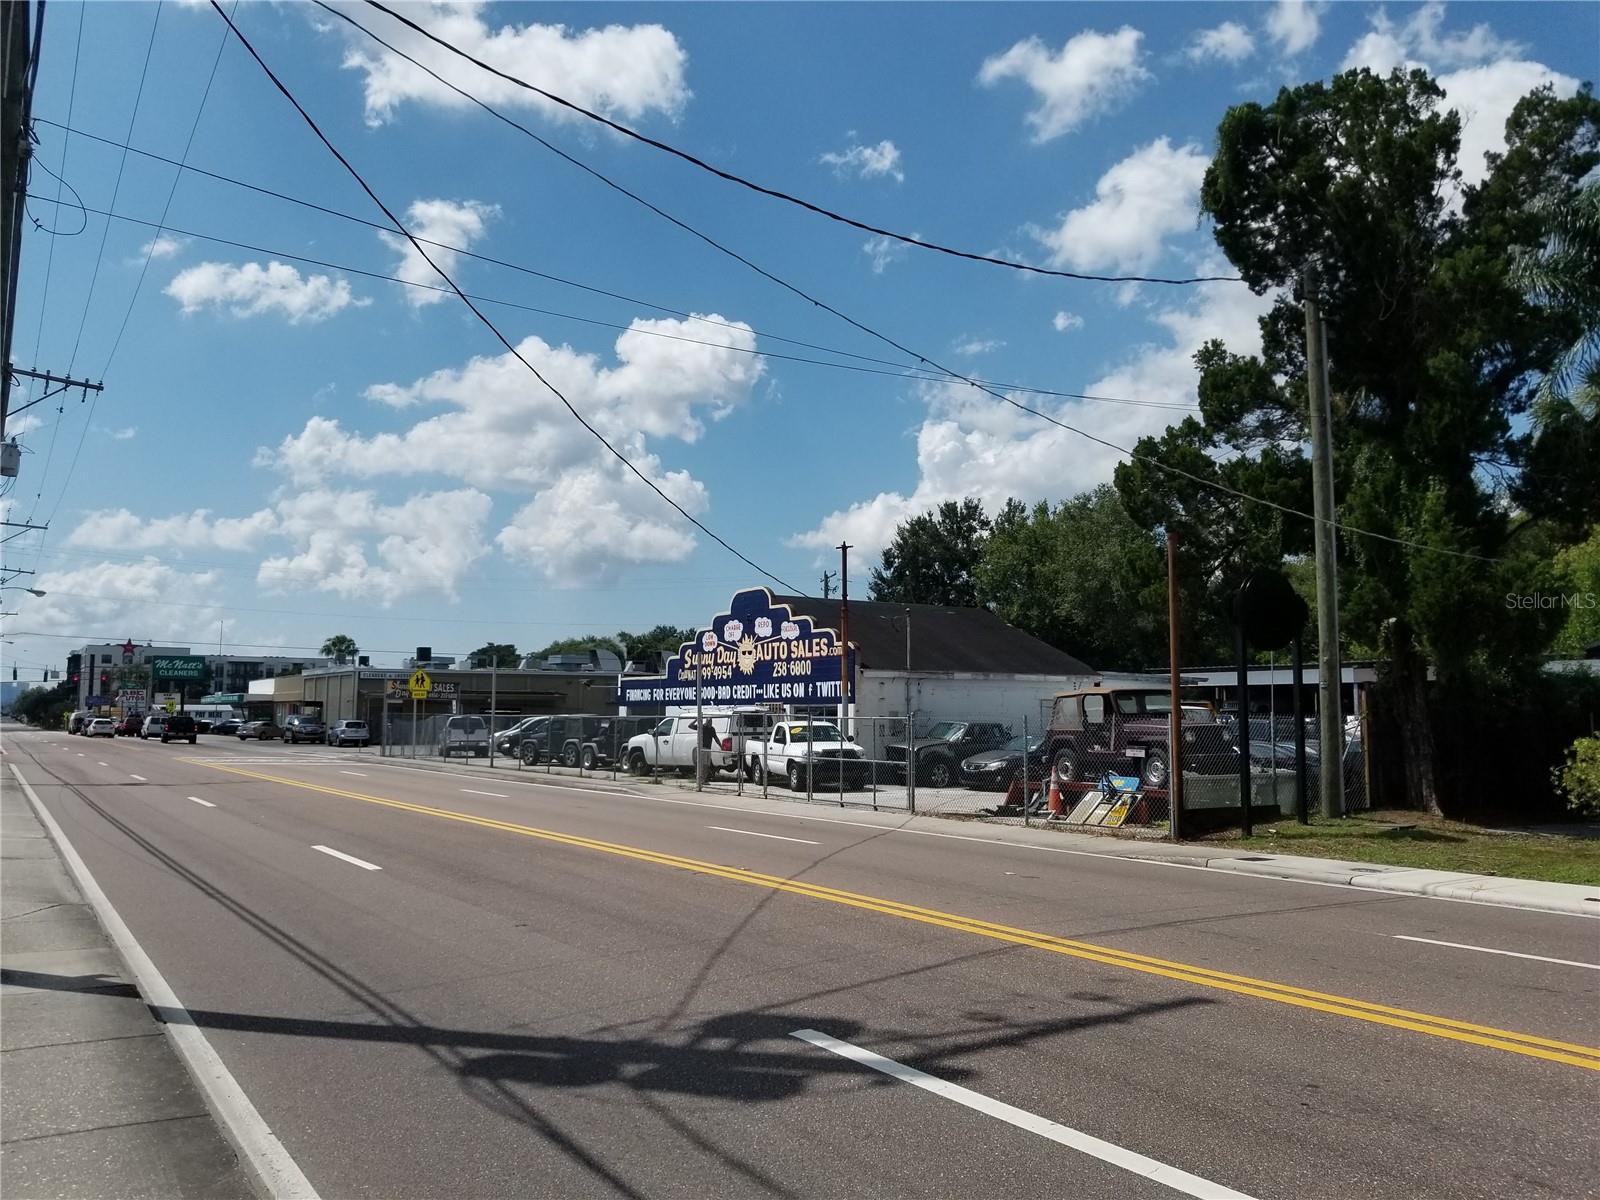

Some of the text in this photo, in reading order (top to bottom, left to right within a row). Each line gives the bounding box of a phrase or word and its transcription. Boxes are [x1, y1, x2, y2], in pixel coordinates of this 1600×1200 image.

[154, 658, 203, 669] McNatt's
[716, 645, 737, 668] Day
[756, 641, 788, 661] AUTO
[653, 688, 664, 701] FOR
[665, 686, 697, 701] EVERYONE
[781, 682, 792, 698] US
[793, 682, 805, 698] ON
[816, 680, 852, 697] TWITTR
